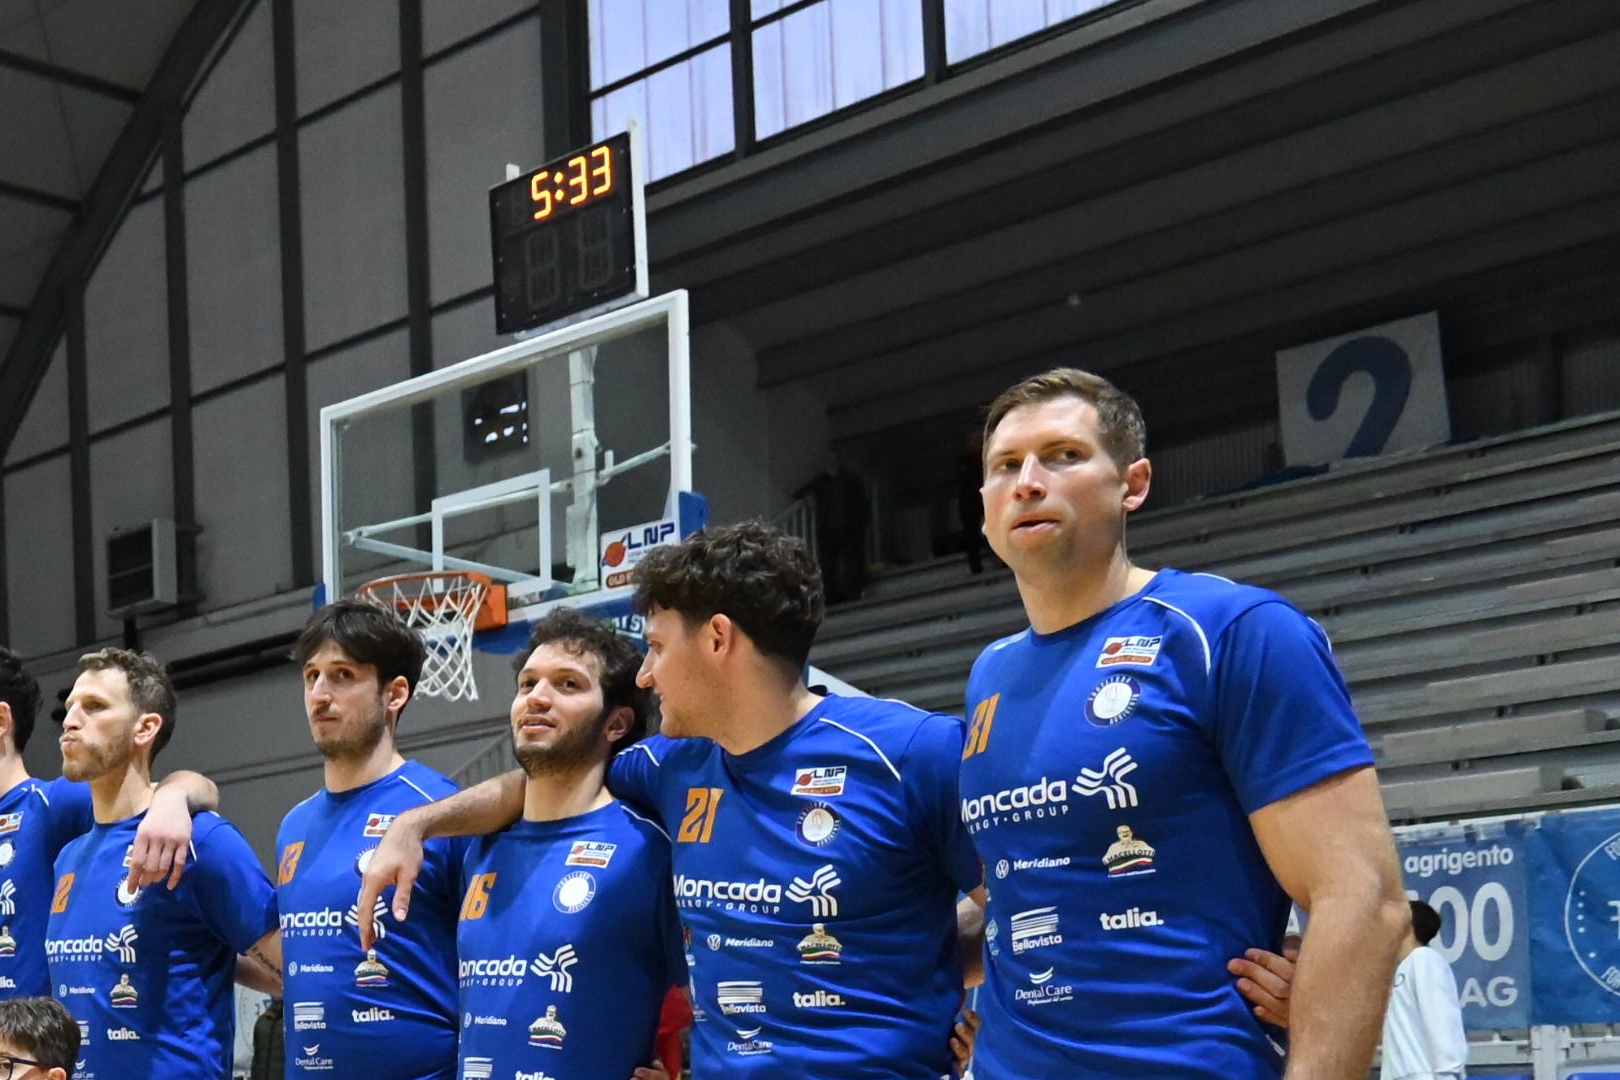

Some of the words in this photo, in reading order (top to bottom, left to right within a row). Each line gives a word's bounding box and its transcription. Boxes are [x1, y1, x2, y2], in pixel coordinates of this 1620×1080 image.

[531, 145, 611, 220] 5:33
[1306, 336, 1412, 460] 2
[627, 522, 675, 550] LNP
[813, 767, 845, 778] LNP
[677, 787, 724, 843] 21
[1013, 857, 1070, 871] Meridiano
[1404, 844, 1513, 878] agrigento
[459, 871, 497, 921] 16
[725, 901, 780, 914] GROUP
[1406, 882, 1513, 964] 00
[725, 937, 774, 948] Meridiano
[1012, 933, 1063, 952] Bellavista
[1045, 984, 1073, 997] Care
